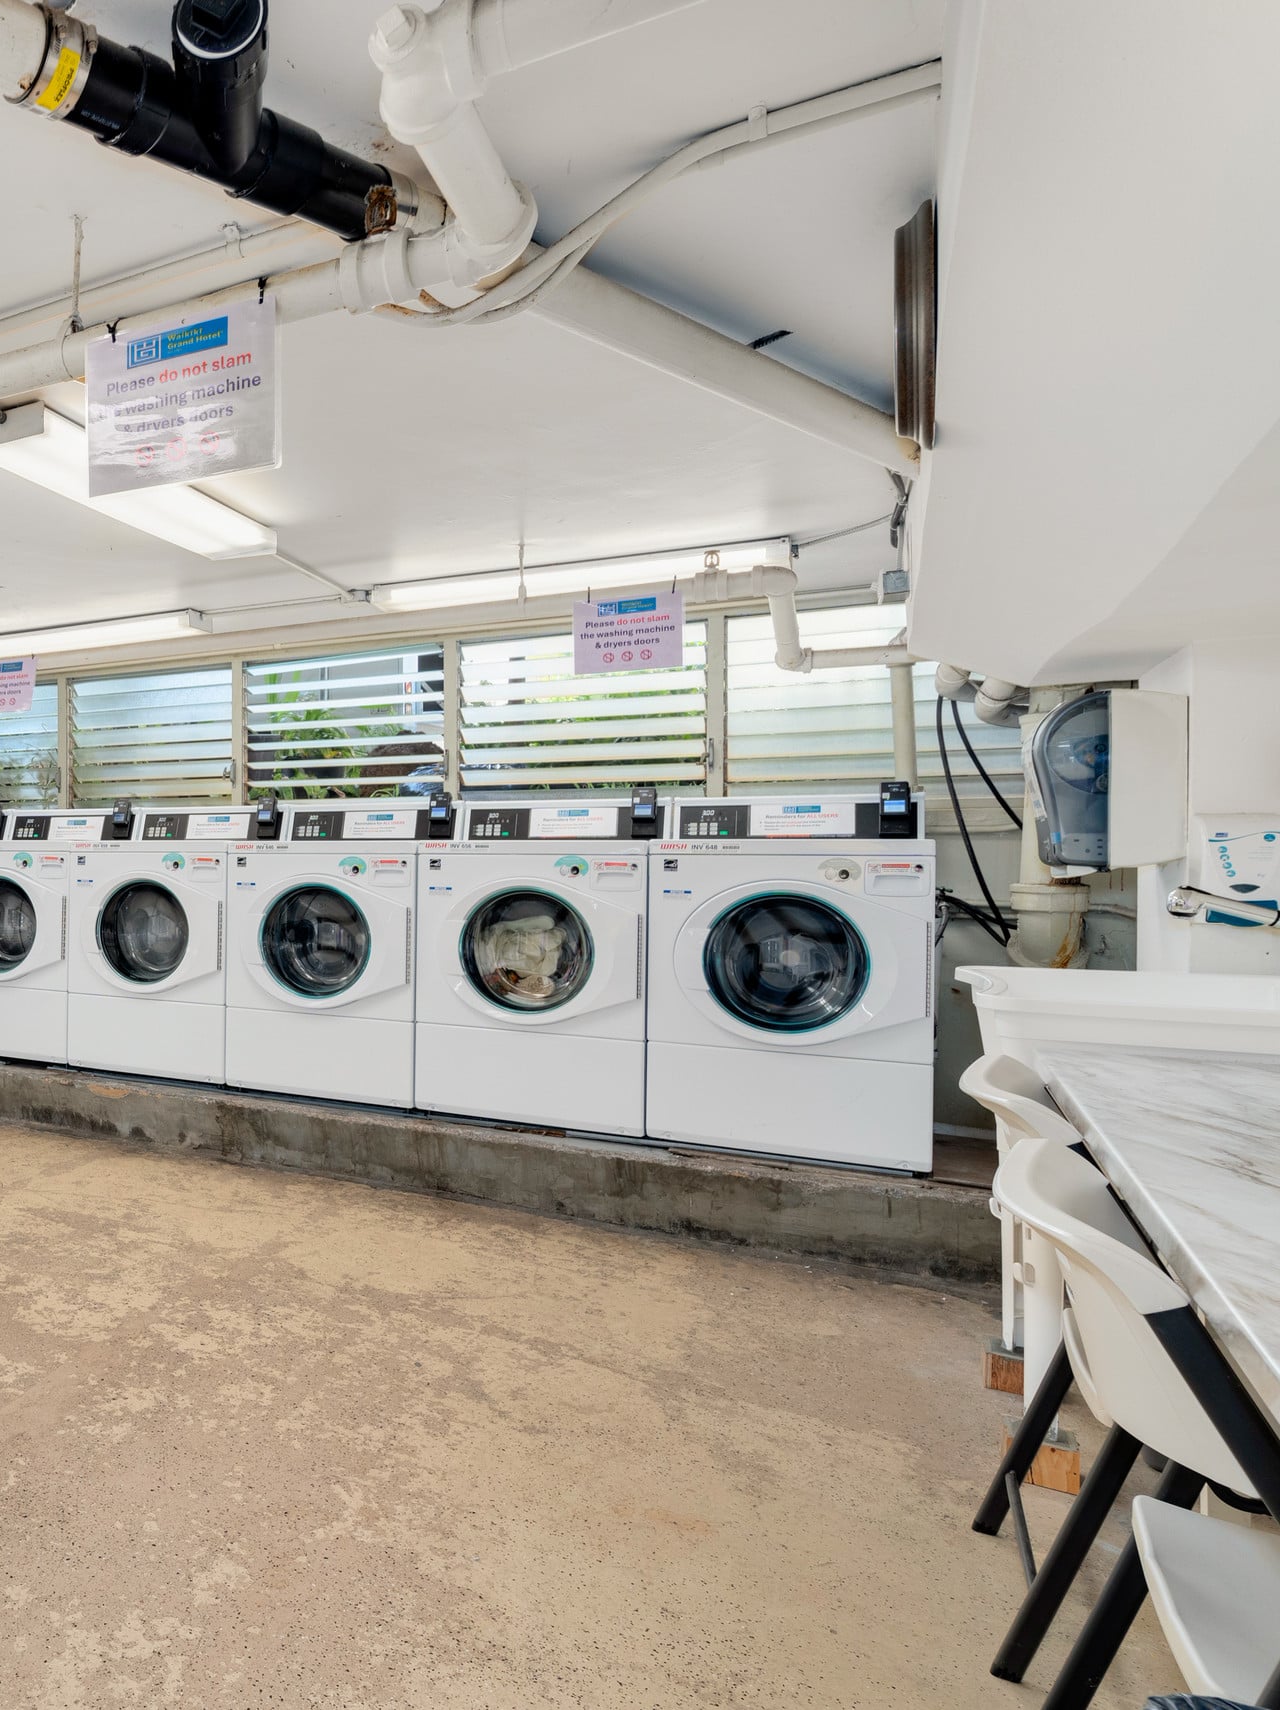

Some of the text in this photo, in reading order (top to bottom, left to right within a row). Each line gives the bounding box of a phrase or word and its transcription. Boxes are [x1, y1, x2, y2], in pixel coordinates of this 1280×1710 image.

[54, 68, 74, 102] PROFLEX
[168, 328, 203, 342] Waikiki
[168, 330, 221, 350] Grand Hotel
[106, 352, 252, 396] Please do not slam
[192, 375, 262, 401] machine
[585, 620, 614, 629] Please
[647, 614, 670, 622] slam
[580, 625, 676, 640] the washing machine
[604, 640, 632, 650] dryers
[634, 637, 660, 646] doors
